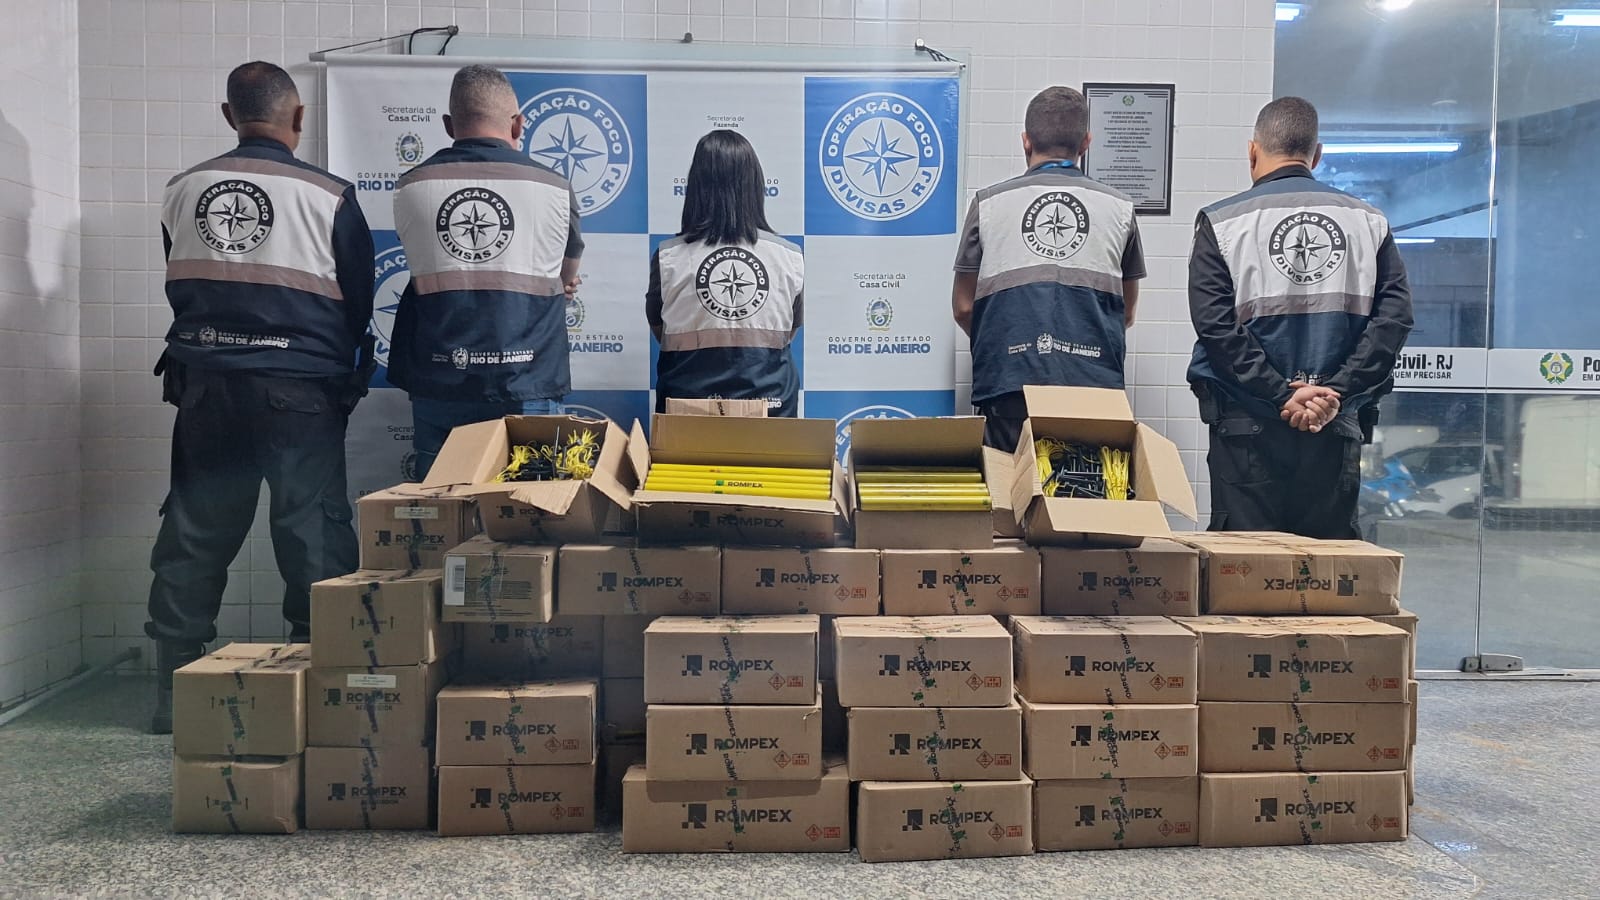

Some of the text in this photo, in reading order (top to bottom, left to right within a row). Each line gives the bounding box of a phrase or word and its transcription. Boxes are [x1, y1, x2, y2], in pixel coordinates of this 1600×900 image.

[381, 105, 437, 114] Secretaria da
[387, 114, 431, 123] Casa Civil
[593, 108, 623, 155] FOCO
[828, 98, 934, 158] OPERAÇÃO FOCO
[357, 180, 382, 191] RIO
[600, 167, 623, 194] RJ
[830, 169, 933, 215] DIVISAS RJ
[198, 181, 270, 222] OPERAÇÃO FOCO
[439, 189, 511, 227] OPERAÇÃO FOCO
[1025, 193, 1086, 229] OPERAÇÃO FOCO
[198, 219, 267, 252] DIVISAS RJ
[1272, 213, 1342, 250] OPERAÇÃO FOCO
[441, 231, 509, 262] DIVISAS RJ
[1070, 233, 1084, 250] RJ
[699, 249, 766, 286] OPERAÇÃO FOCO
[1275, 251, 1342, 283] DIVISAS RJ
[853, 272, 906, 280] Secretaria da
[859, 280, 900, 289] Casa Civil
[700, 289, 764, 319] DIVISAS RJ
[218, 336, 289, 349] RIO DE JANEIRO
[828, 343, 931, 355] RIO DE JANEIRO
[470, 354, 534, 364] RIO DE JANEIRO
[1436, 354, 1453, 370] RJ
[1413, 371, 1452, 379] PRECISAR
[727, 480, 764, 489] ROMPEX
[623, 576, 683, 588] ROMPEX
[781, 573, 840, 584] ROMPEX
[943, 574, 1002, 585] ROMPEX
[1103, 576, 1162, 587] ROMPEX
[708, 659, 774, 671] ROMPEX
[906, 660, 972, 672] ROMPEX
[1092, 661, 1156, 673] ROMPEX
[1279, 660, 1353, 674] ROMPEX
[492, 724, 556, 736] ROMPEX
[714, 737, 779, 750] ROMPEX
[1283, 732, 1355, 745] ROMPEX
[498, 791, 561, 803] ROMPEX
[1285, 801, 1356, 816] ROMPEX
[714, 809, 793, 823] ROMPEX
